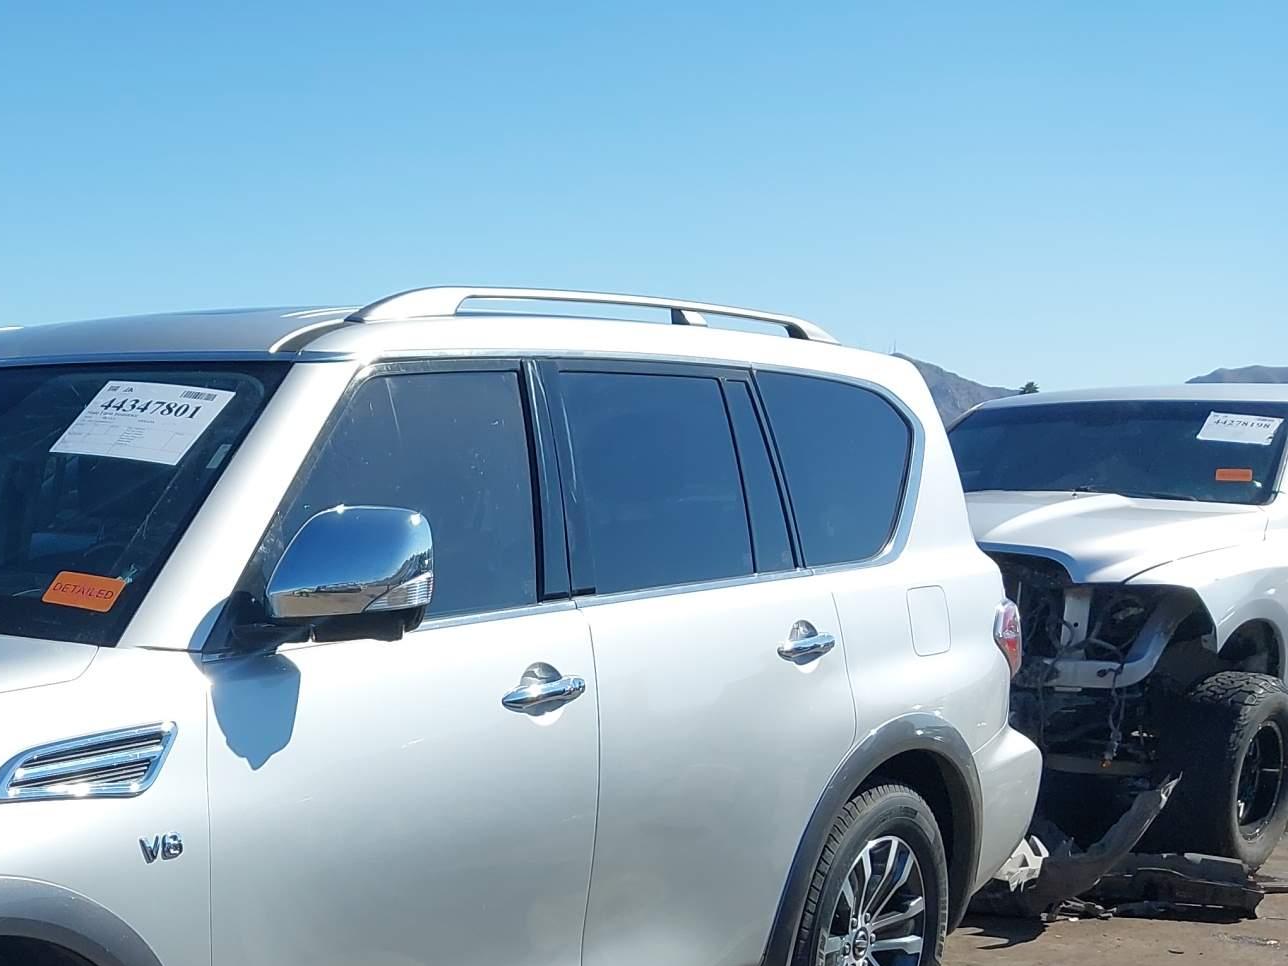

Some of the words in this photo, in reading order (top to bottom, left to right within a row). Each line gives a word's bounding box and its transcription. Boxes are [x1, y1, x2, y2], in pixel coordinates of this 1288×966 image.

[100, 398, 202, 419] 44347801
[52, 582, 114, 600] DETAILED
[138, 832, 184, 864] V8
